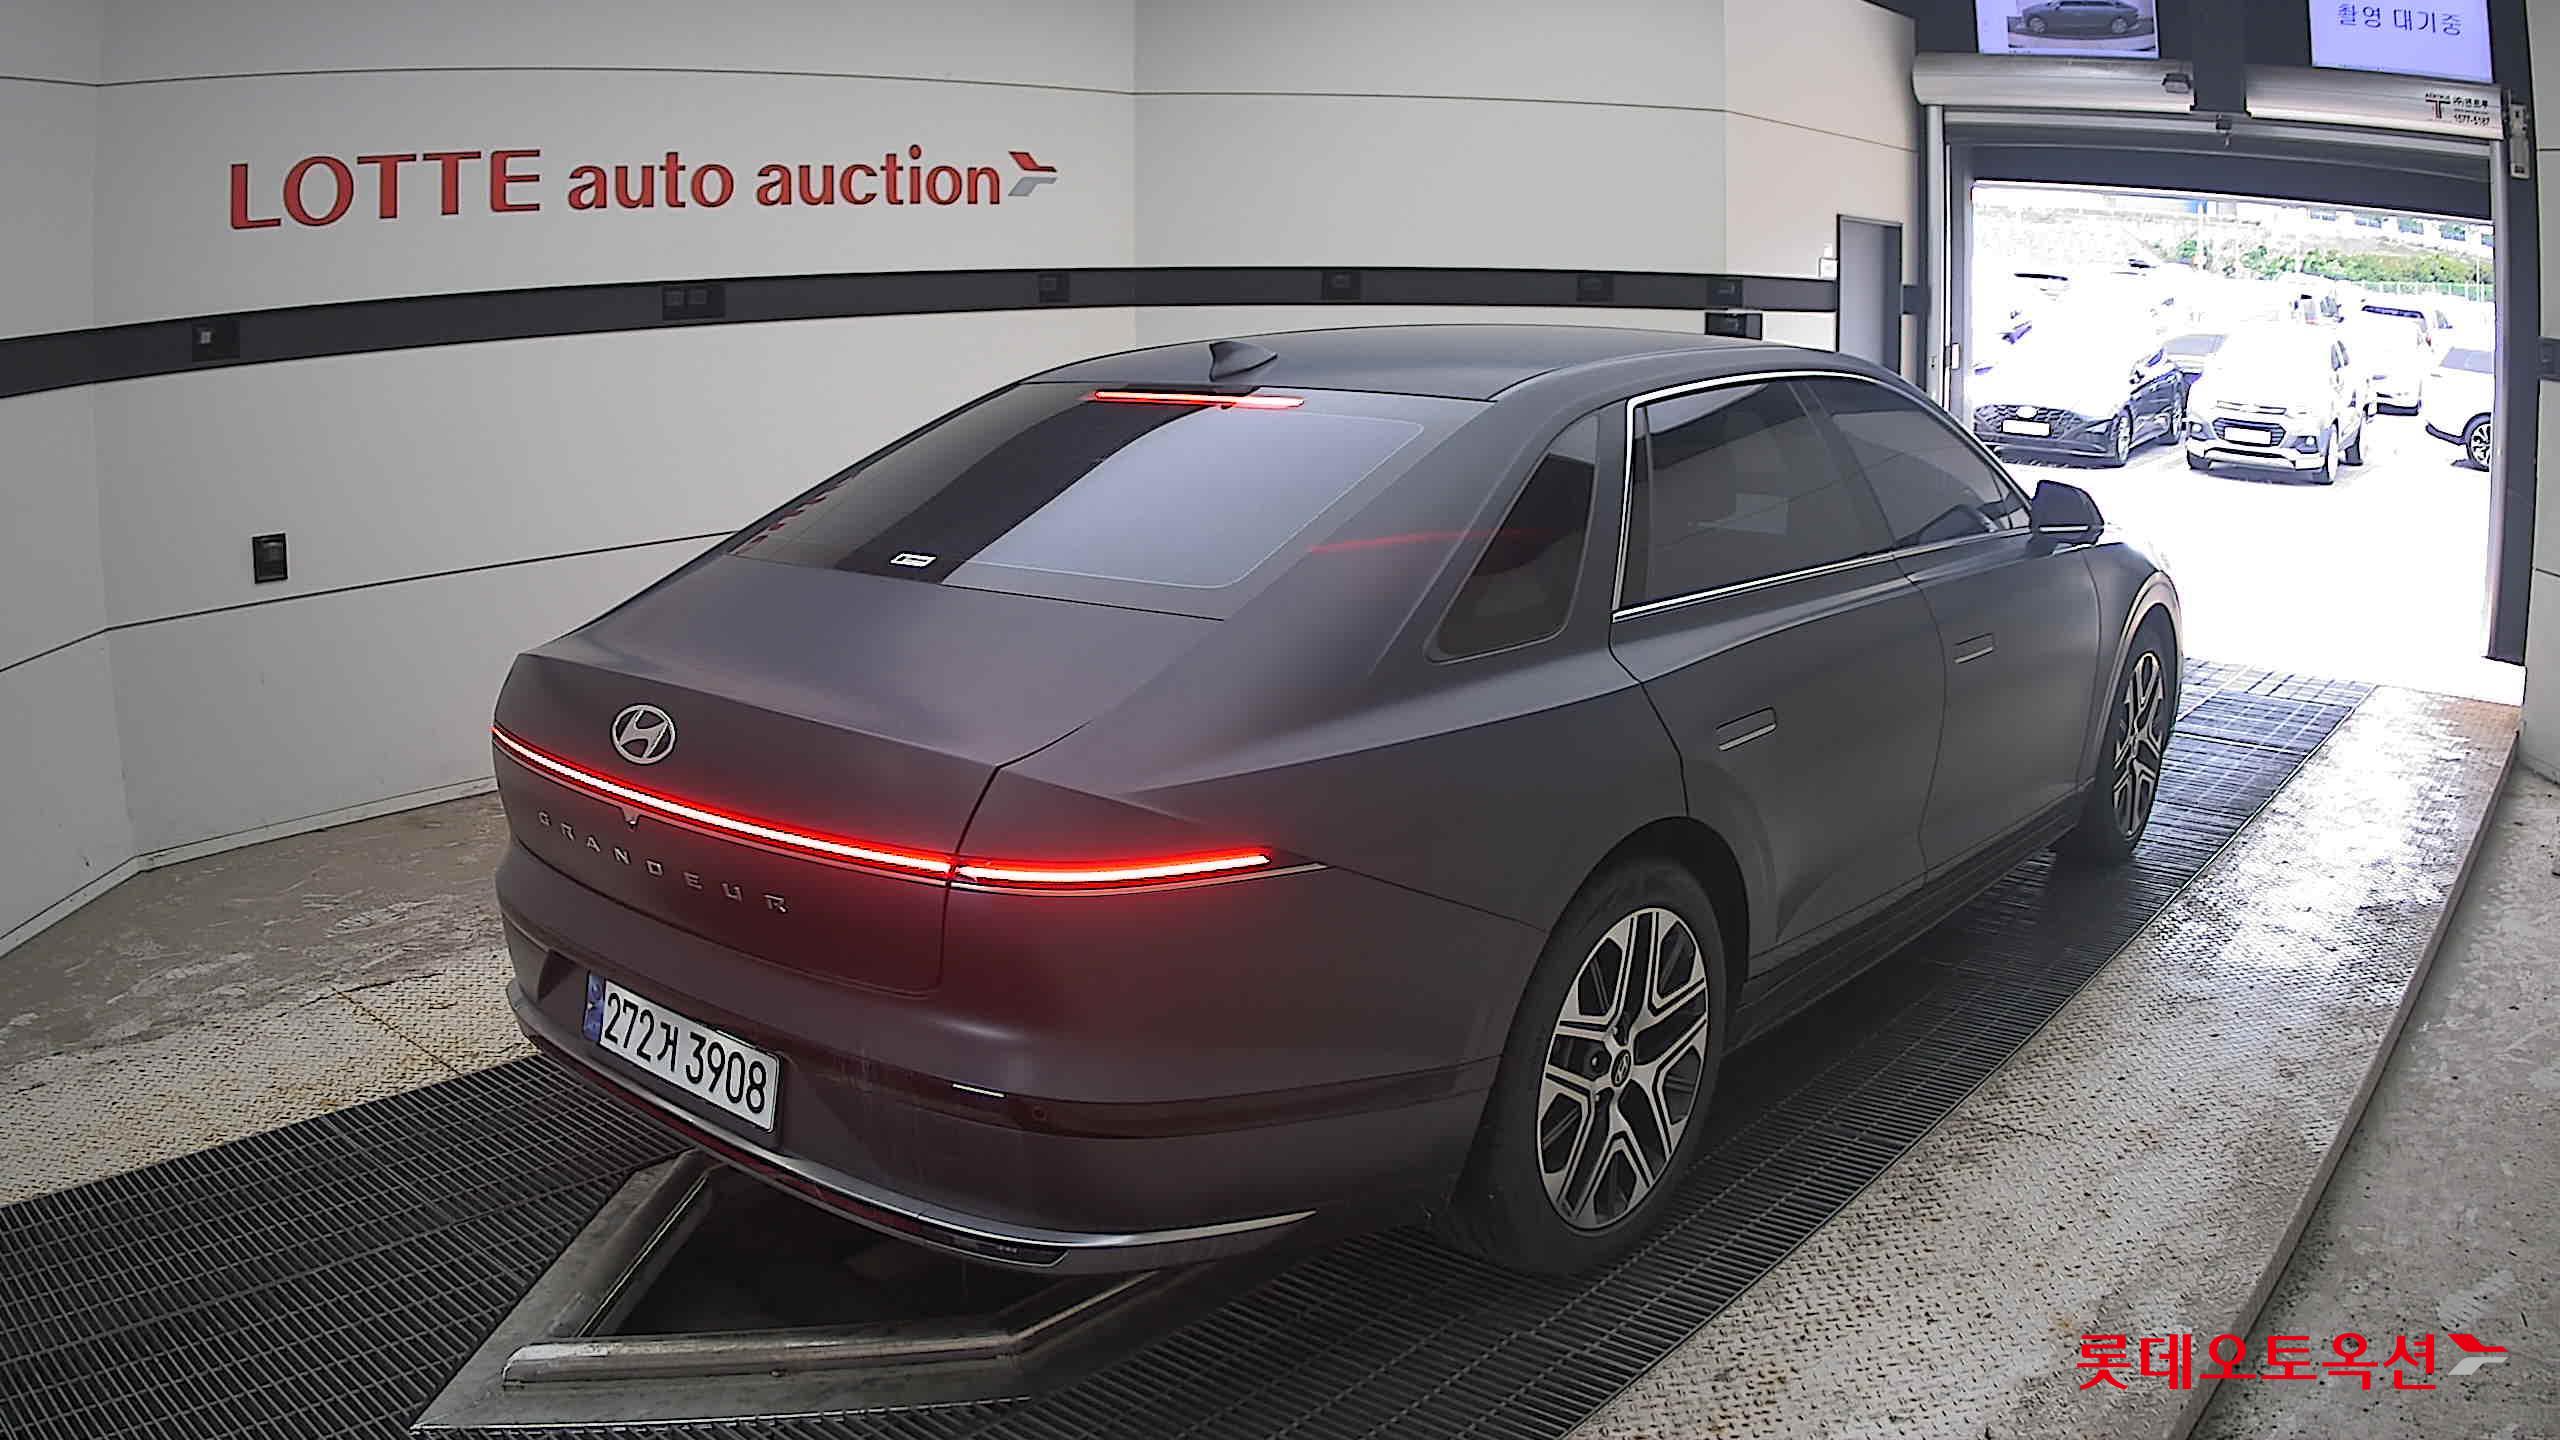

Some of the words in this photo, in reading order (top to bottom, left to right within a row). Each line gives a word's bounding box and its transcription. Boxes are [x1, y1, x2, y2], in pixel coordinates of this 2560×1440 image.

[2393, 8, 2461, 36] 대기중
[230, 150, 541, 230] LOTTE
[567, 151, 735, 209] auto
[756, 144, 1001, 206] auction
[538, 811, 789, 913] GRANDEUR
[604, 993, 678, 1073] 272거
[686, 1032, 767, 1114] 3908
